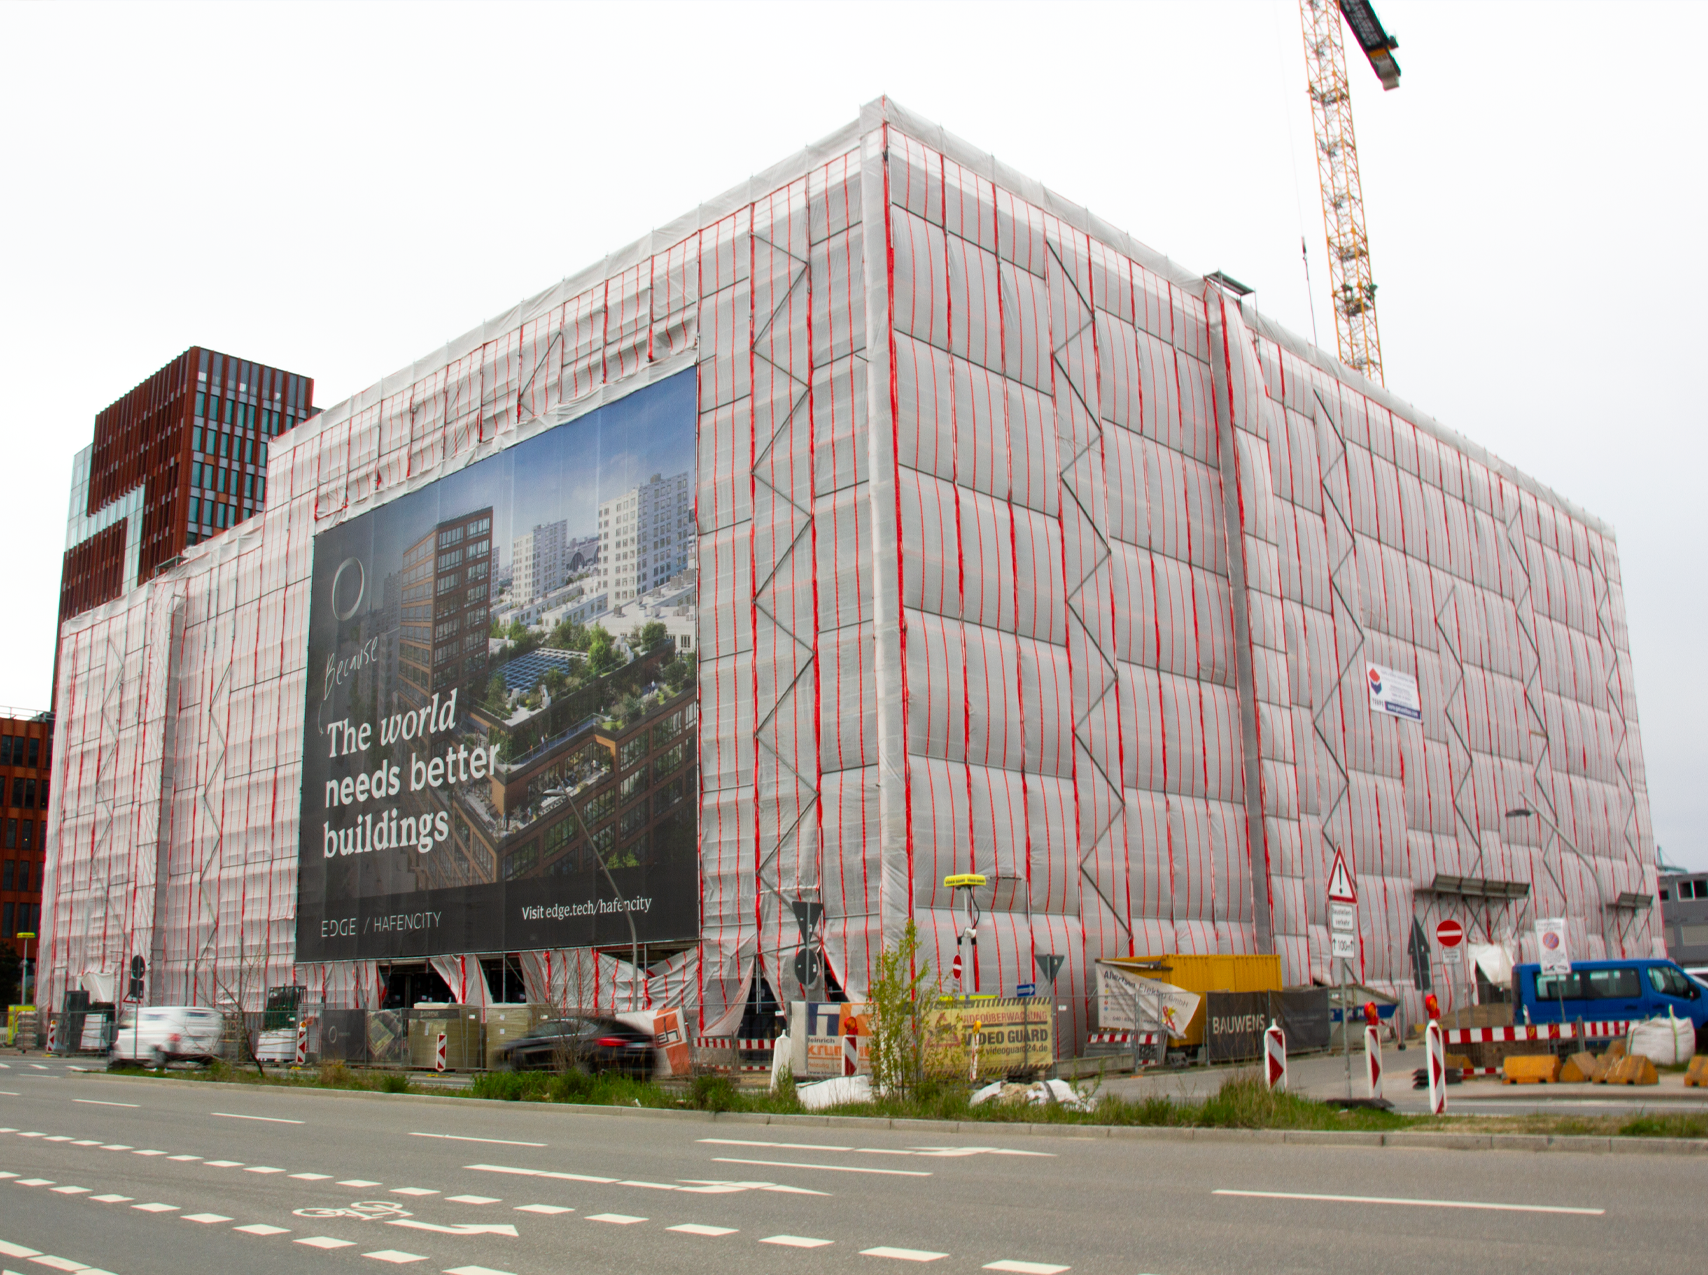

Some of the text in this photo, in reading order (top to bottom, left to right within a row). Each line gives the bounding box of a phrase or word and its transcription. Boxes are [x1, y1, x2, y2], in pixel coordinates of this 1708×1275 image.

[324, 636, 378, 701] Because
[327, 687, 458, 758] The world
[325, 743, 500, 808] needs better
[323, 807, 449, 858] buildings
[321, 917, 357, 938] EDGE
[374, 911, 442, 932] HAFENCITY
[522, 905, 544, 920] Visit
[1212, 1013, 1266, 1035] BAUWENS
